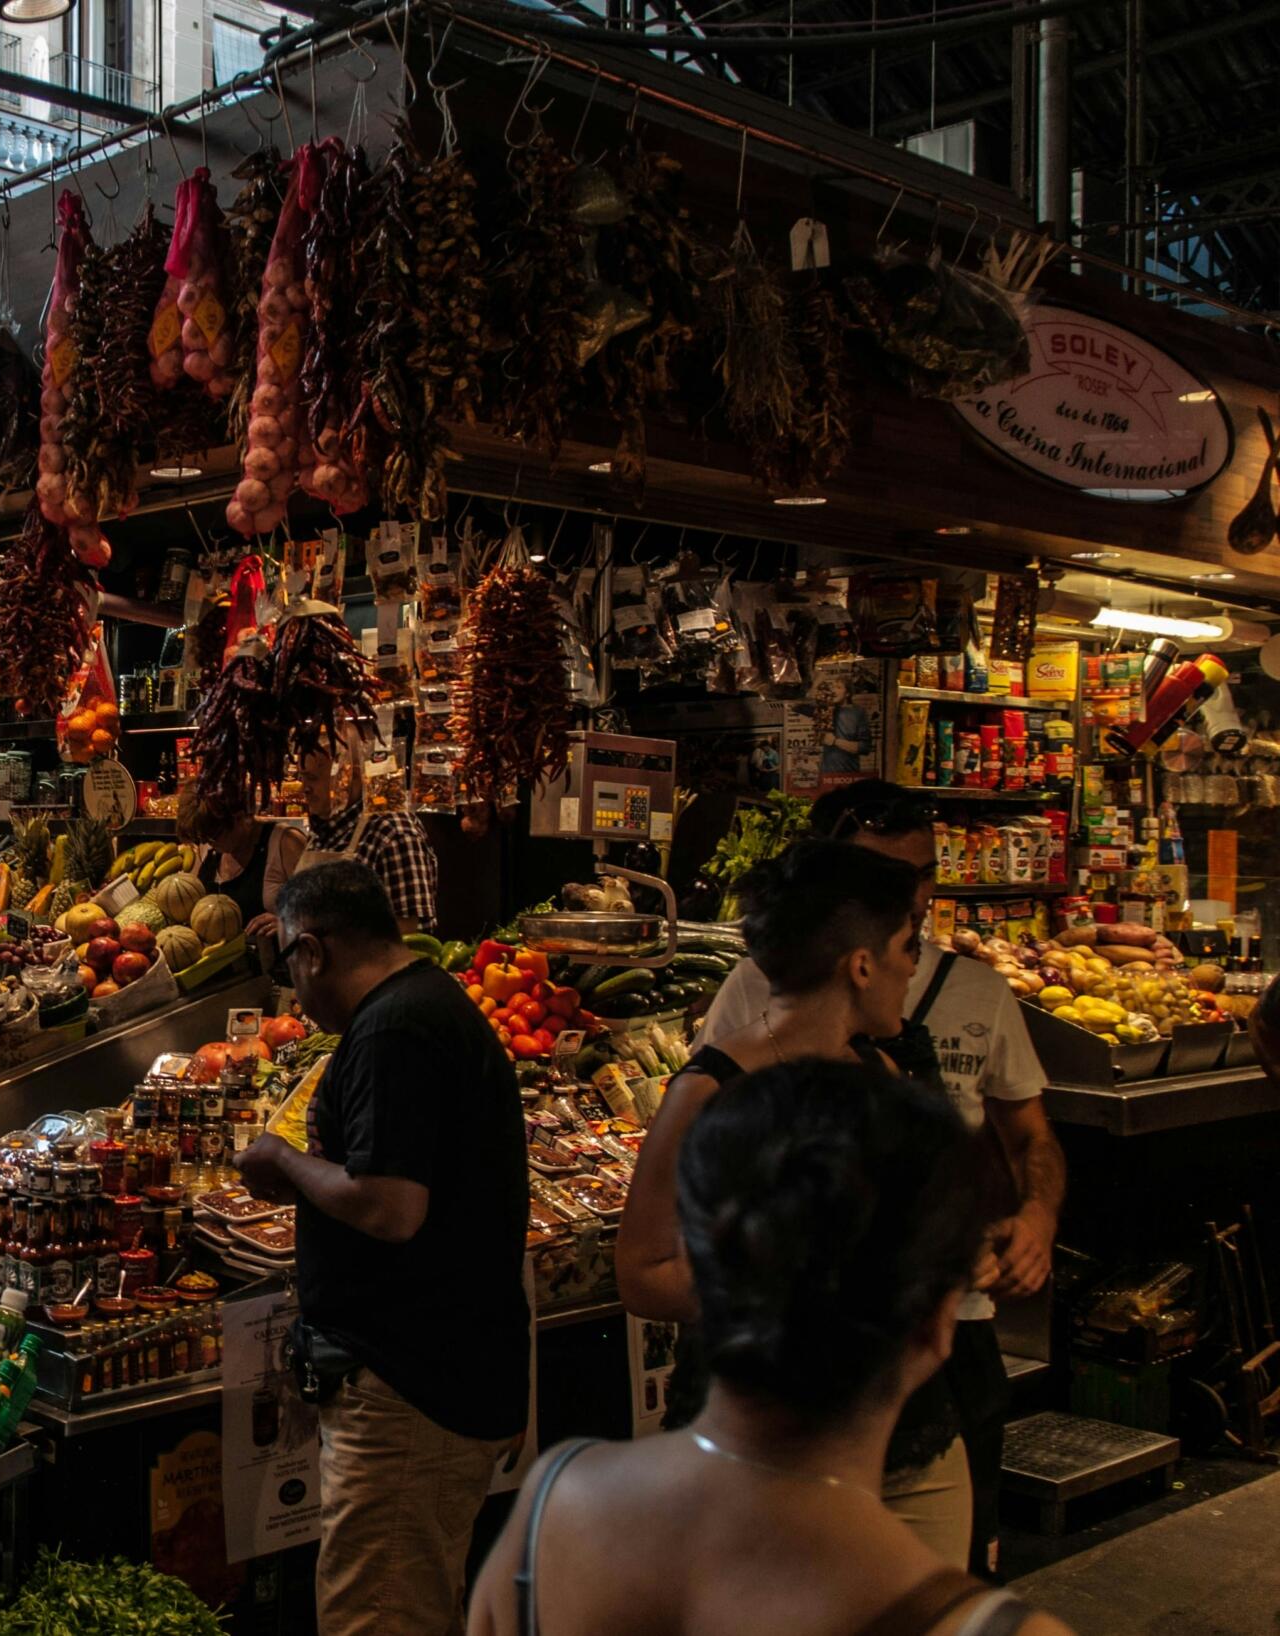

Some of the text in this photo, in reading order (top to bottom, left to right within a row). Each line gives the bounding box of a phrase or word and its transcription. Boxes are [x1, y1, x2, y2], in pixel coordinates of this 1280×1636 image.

[1050, 333, 1137, 376] SOLEY
[1055, 401, 1078, 421] des
[1082, 408, 1098, 426] de
[997, 400, 1061, 462] Cuina
[1066, 437, 1208, 481] Internacional
[162, 1462, 222, 1487] MARTINE
